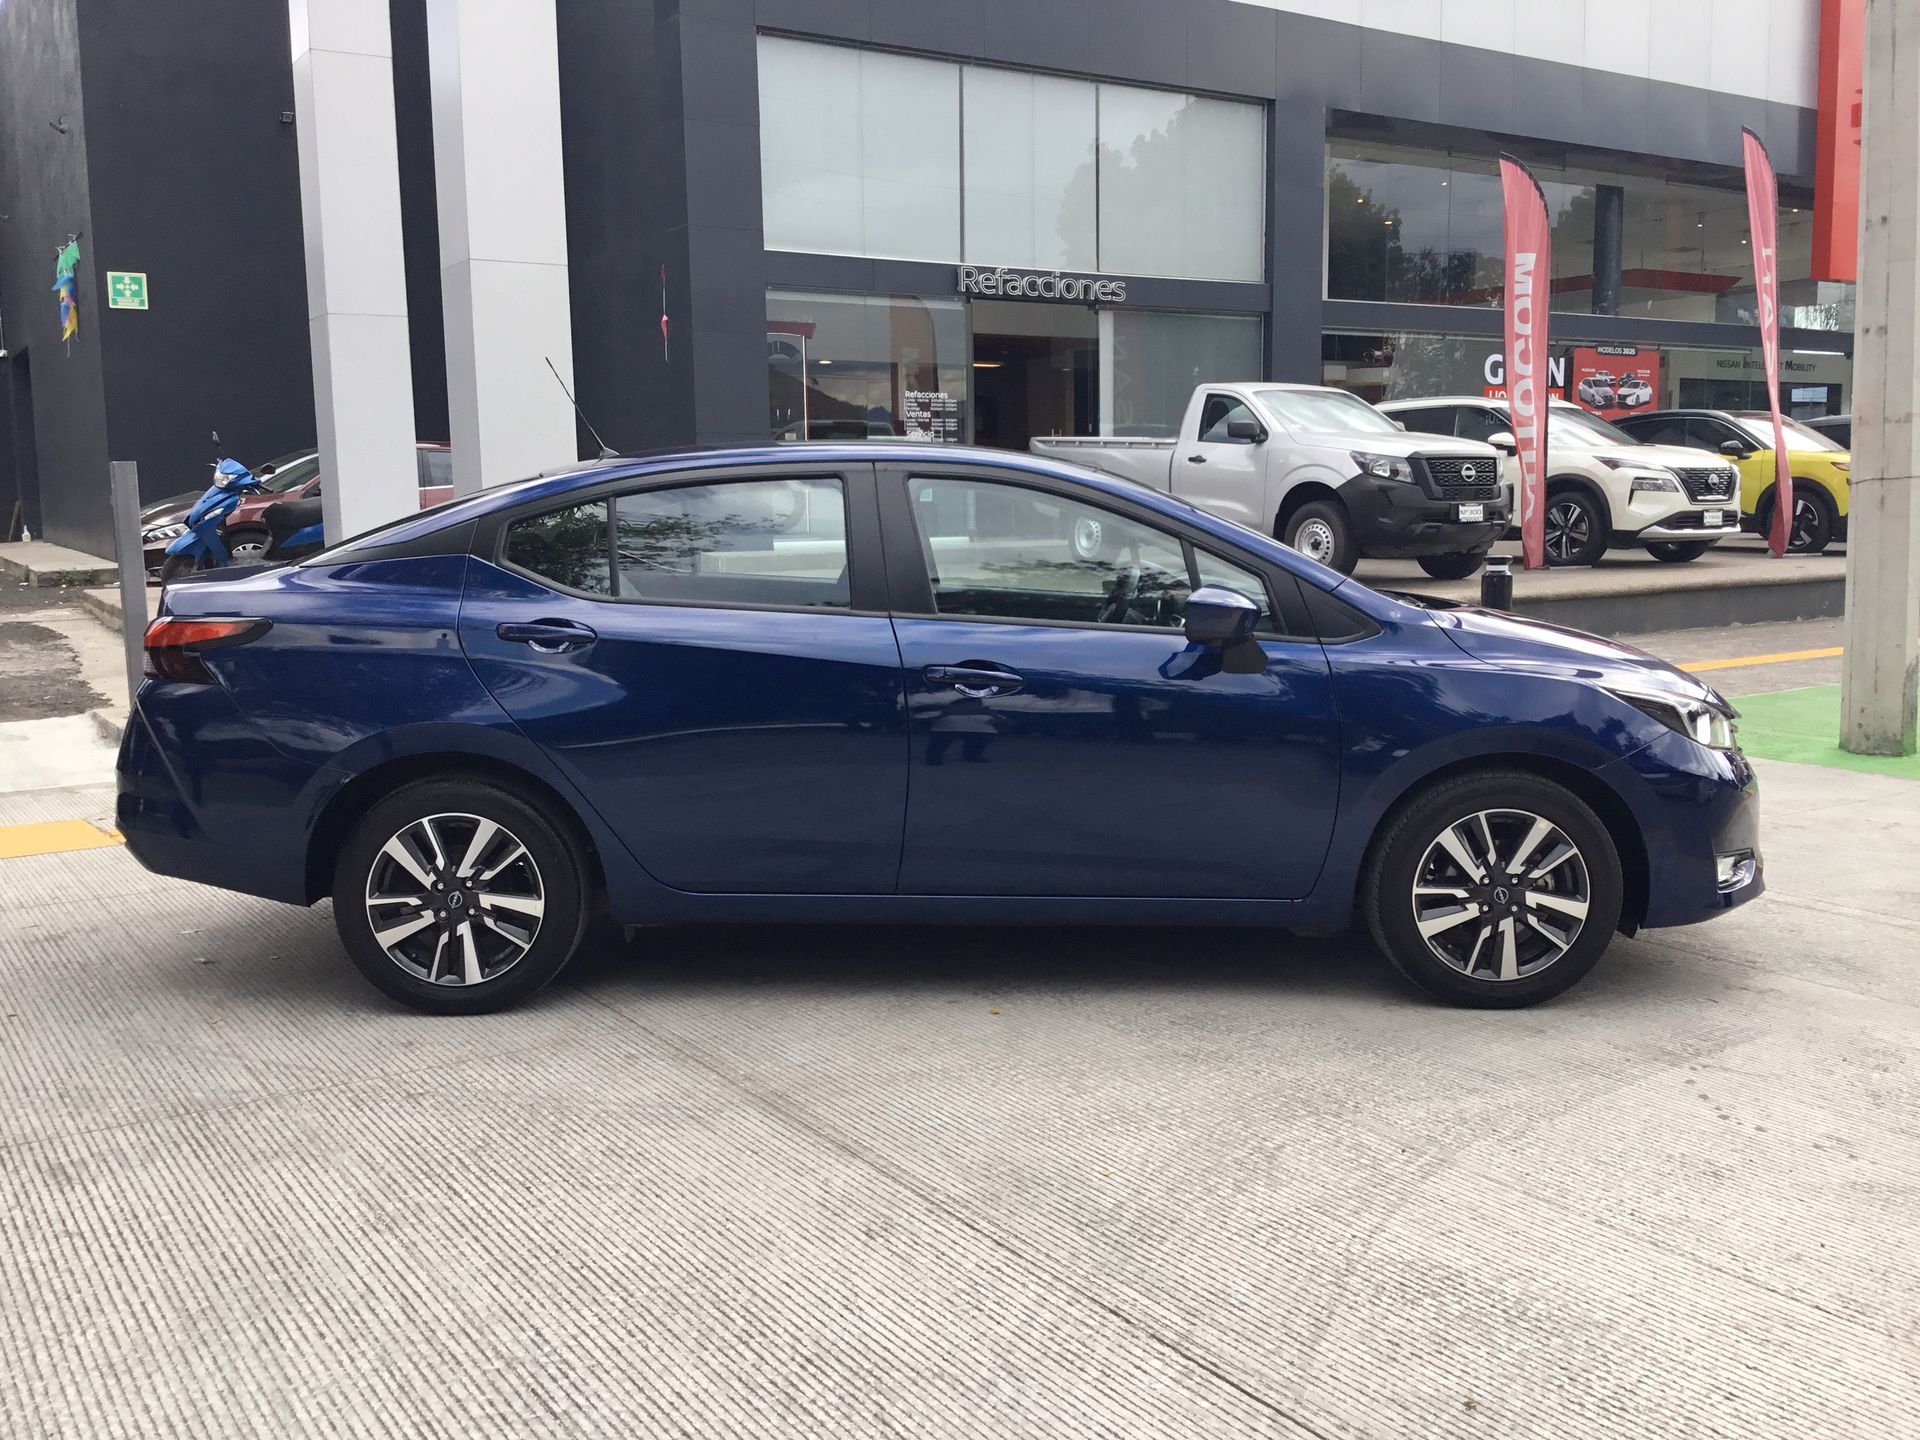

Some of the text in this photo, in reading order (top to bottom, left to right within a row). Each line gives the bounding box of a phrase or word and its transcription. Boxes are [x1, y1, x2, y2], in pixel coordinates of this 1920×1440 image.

[957, 266, 1126, 301] Refacciones
[1597, 346, 1622, 355] MODELOS
[1484, 353, 1566, 387] GN
[905, 390, 949, 399] Refacciones
[905, 410, 932, 418] Ventas
